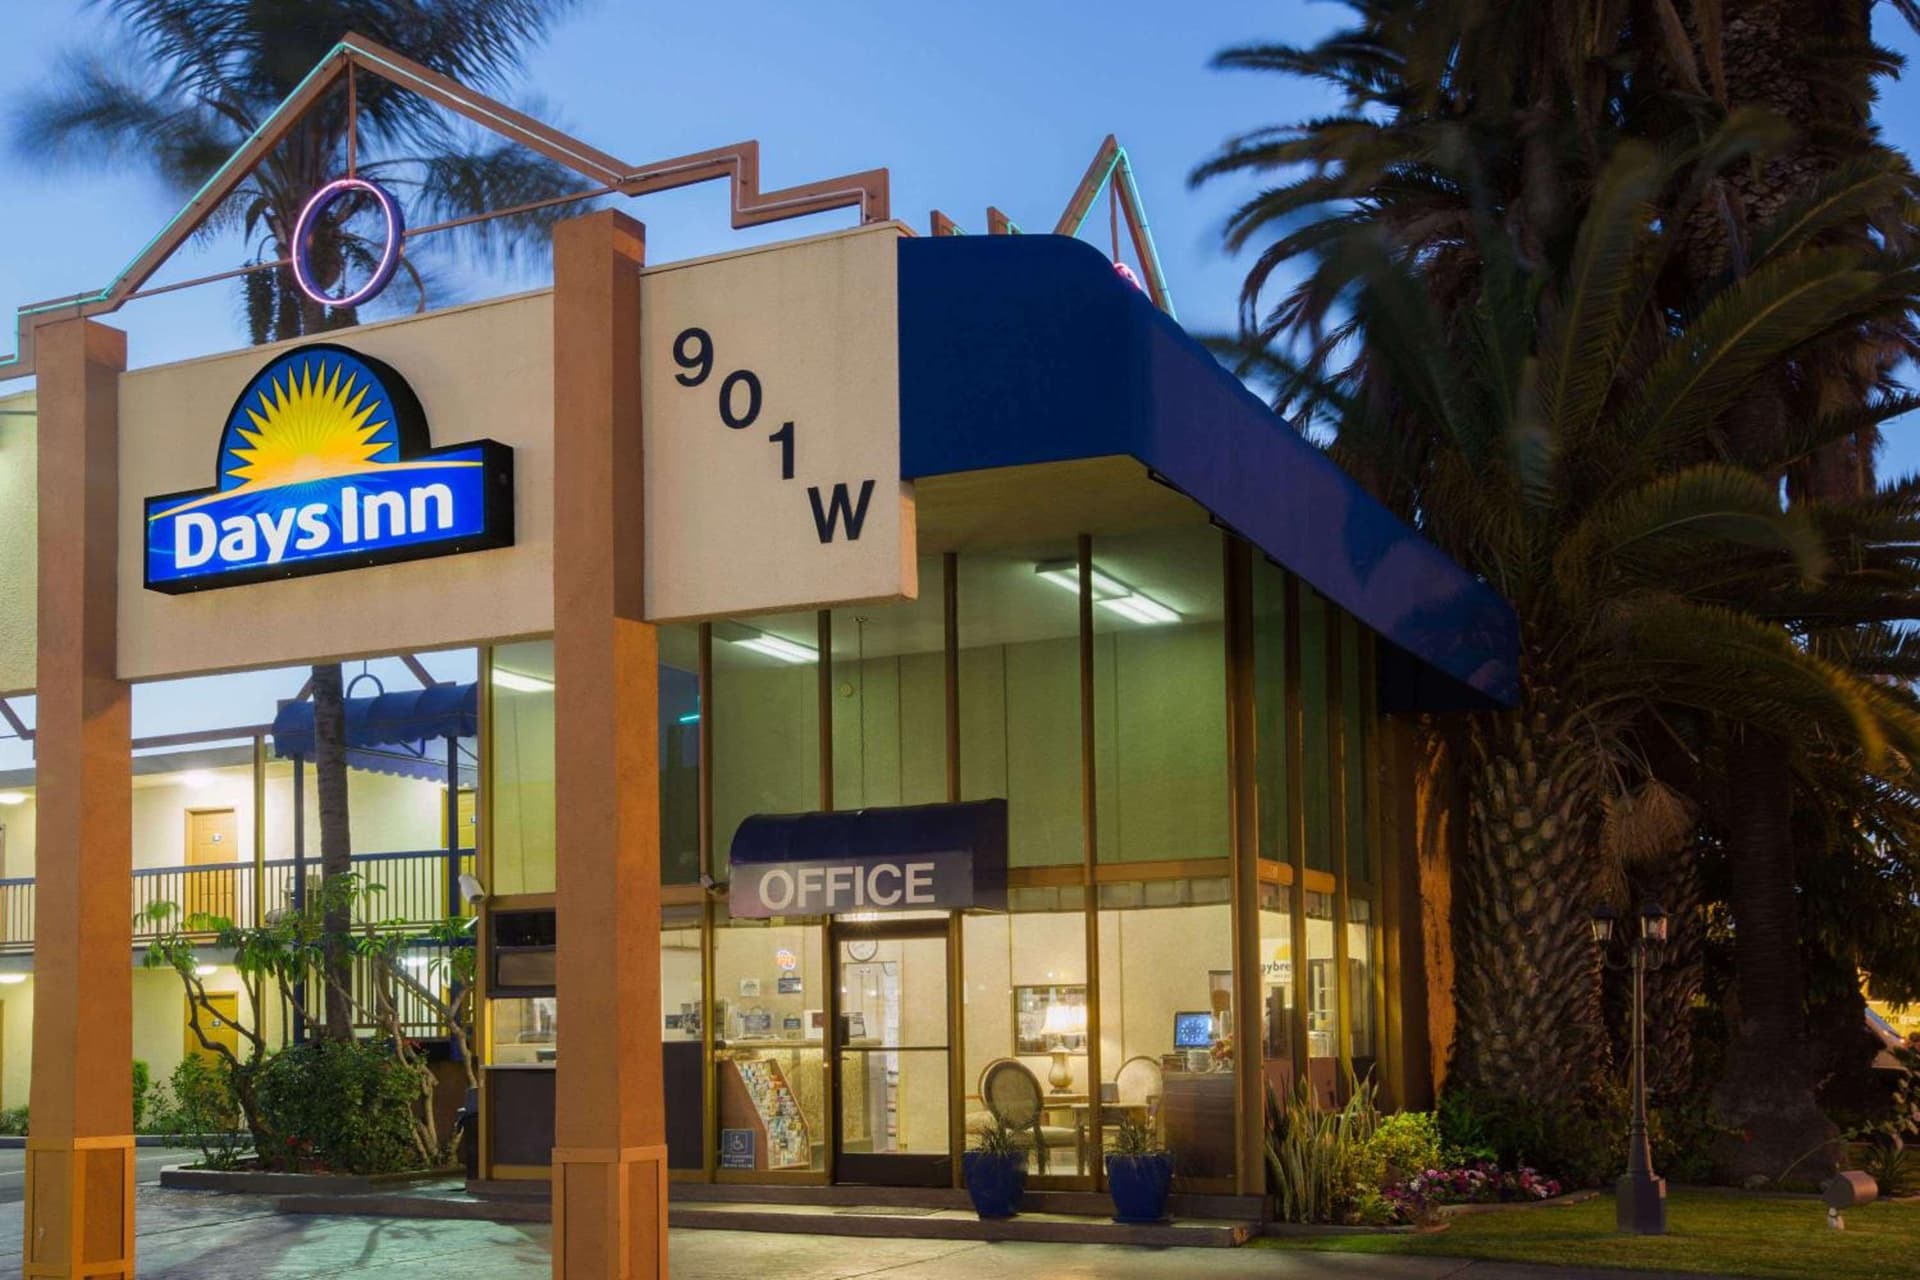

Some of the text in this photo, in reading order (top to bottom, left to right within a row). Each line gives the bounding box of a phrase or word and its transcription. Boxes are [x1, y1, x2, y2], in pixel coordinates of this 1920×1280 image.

[174, 483, 453, 569] Days Inn
[807, 480, 876, 544] W
[758, 862, 936, 911] OFFICE
